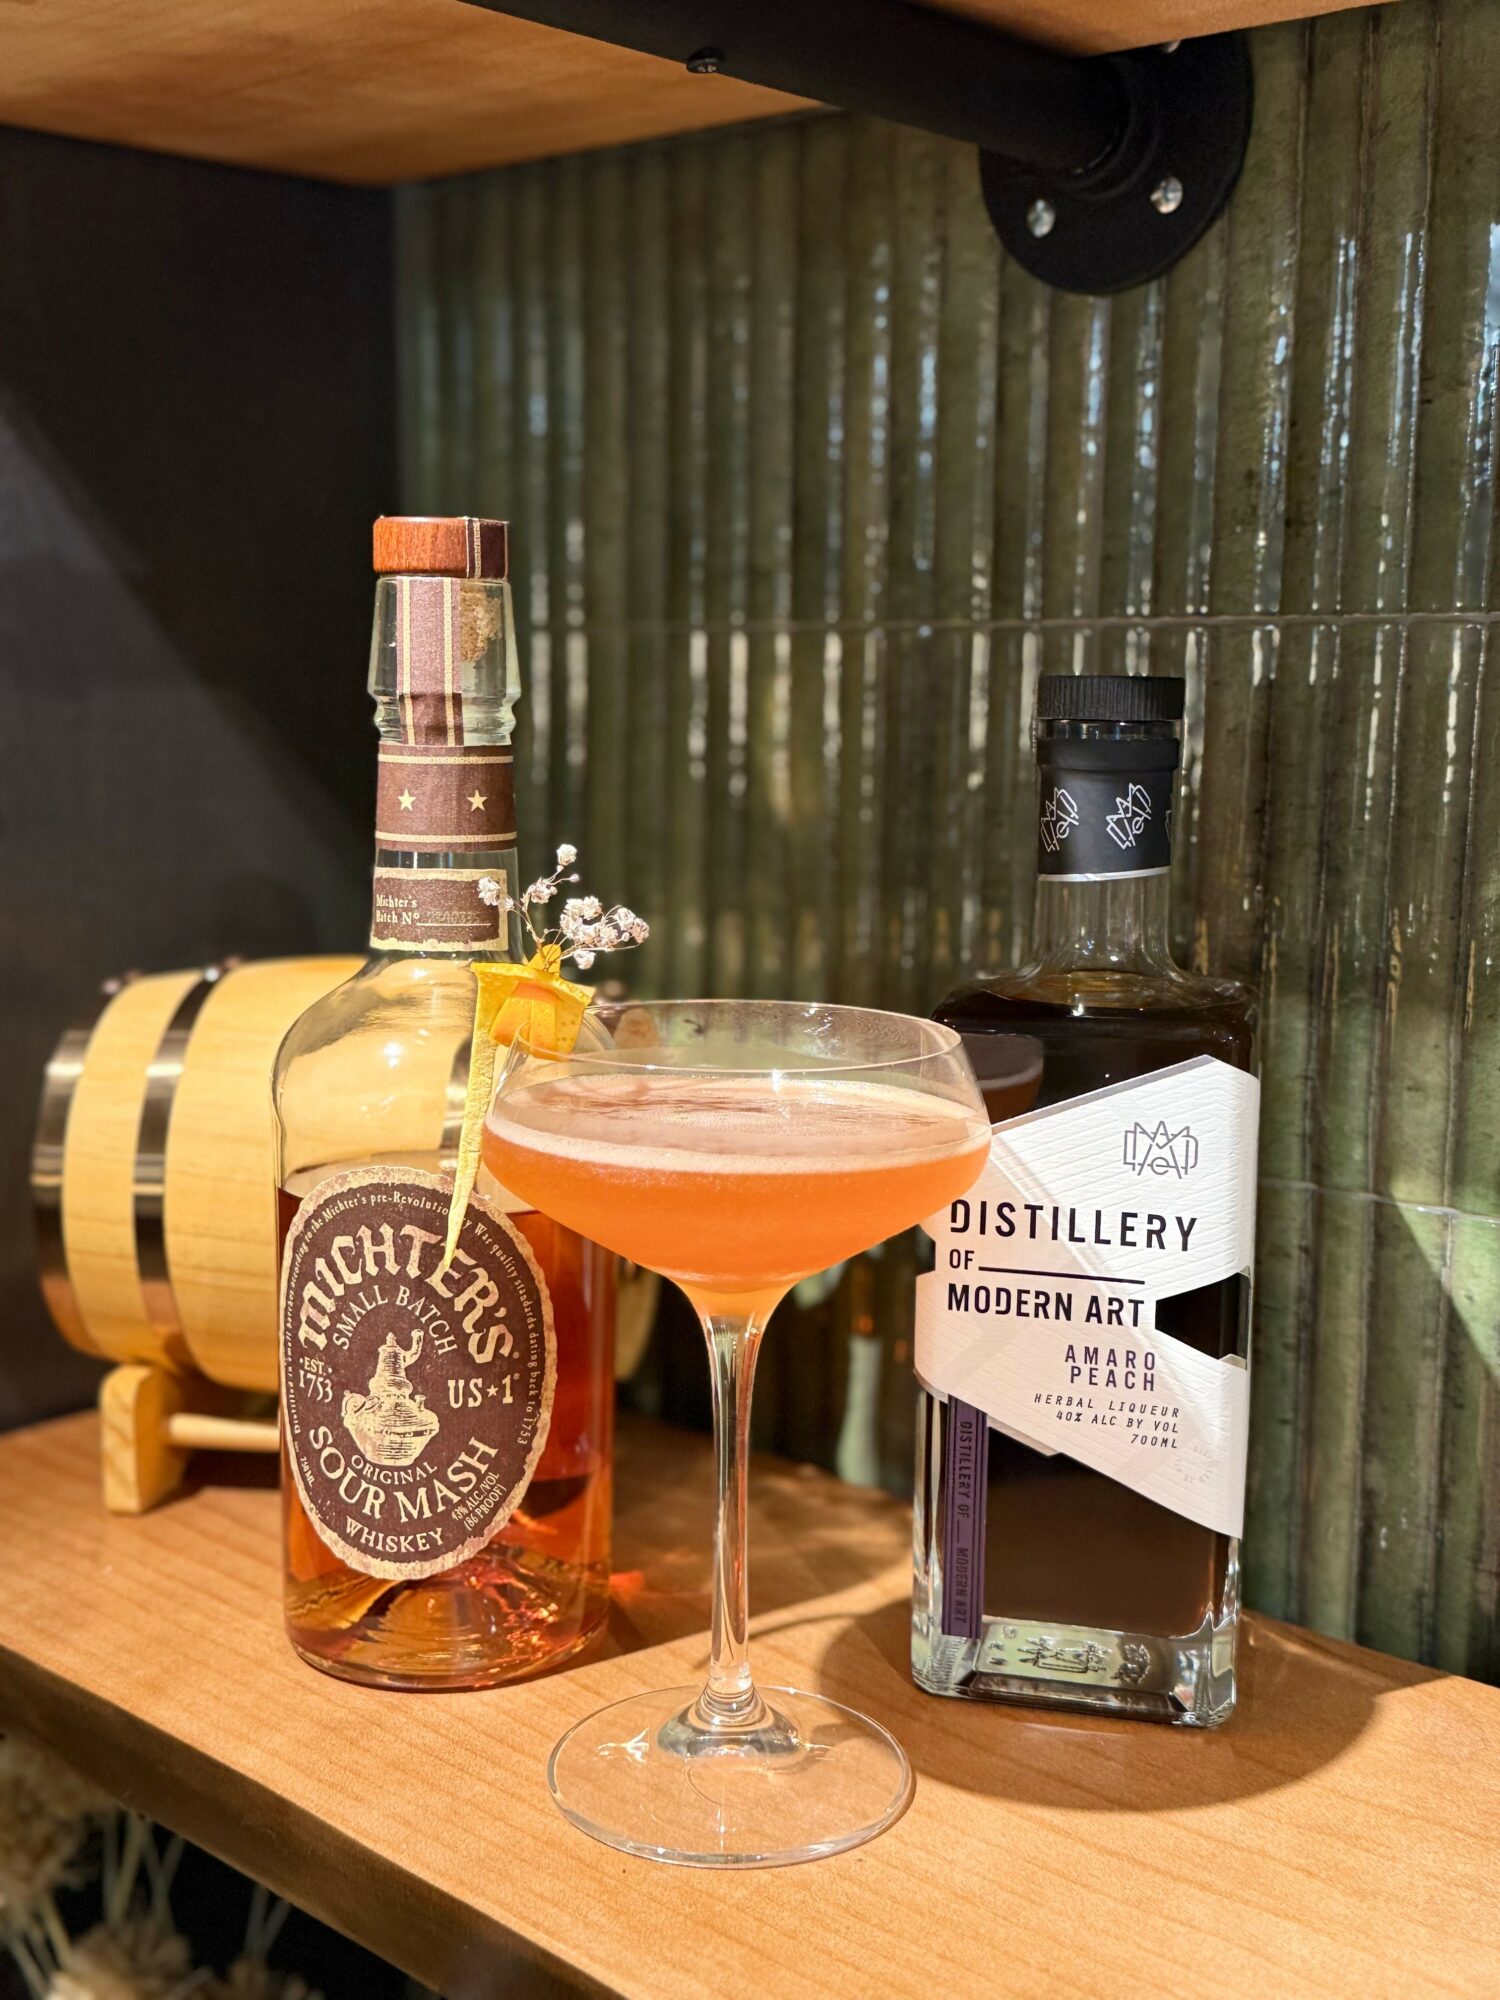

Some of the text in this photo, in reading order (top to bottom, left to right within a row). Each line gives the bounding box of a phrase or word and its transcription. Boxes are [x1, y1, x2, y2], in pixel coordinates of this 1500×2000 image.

[376, 894, 417, 908] Michter's
[376, 910, 398, 923] Batch
[322, 1193, 367, 1222] Michter's
[304, 1231, 313, 1243] to
[311, 1219, 324, 1233] the
[474, 1222, 492, 1245] War
[950, 1199, 1198, 1252] DISTILLERY
[291, 1241, 309, 1288] according
[490, 1244, 518, 1278] quality
[949, 1249, 975, 1270] OF
[514, 1279, 537, 1329] standards
[947, 1283, 1145, 1328] MODERN ART
[333, 1285, 458, 1355] SMALL BATCH
[527, 1332, 540, 1367] dating
[1065, 1344, 1156, 1371] AMARO
[299, 1369, 333, 1403] 1753
[529, 1371, 541, 1396] back
[1070, 1366, 1154, 1392] PEACH
[526, 1400, 536, 1413] to
[1034, 1393, 1180, 1418] HERBAL LIQUEUR
[517, 1418, 534, 1445] 1753
[1056, 1410, 1179, 1433] 40% ALC BY VOL
[1130, 1434, 1178, 1449] 700ML
[309, 1426, 499, 1523] SOUR MASH
[351, 1455, 438, 1485] ORIGINAL
[463, 1483, 507, 1531] (86 PROOF)
[346, 1515, 444, 1553] WHISKEY
[954, 1421, 972, 1624] DISTILLERY OF MODERN ART
